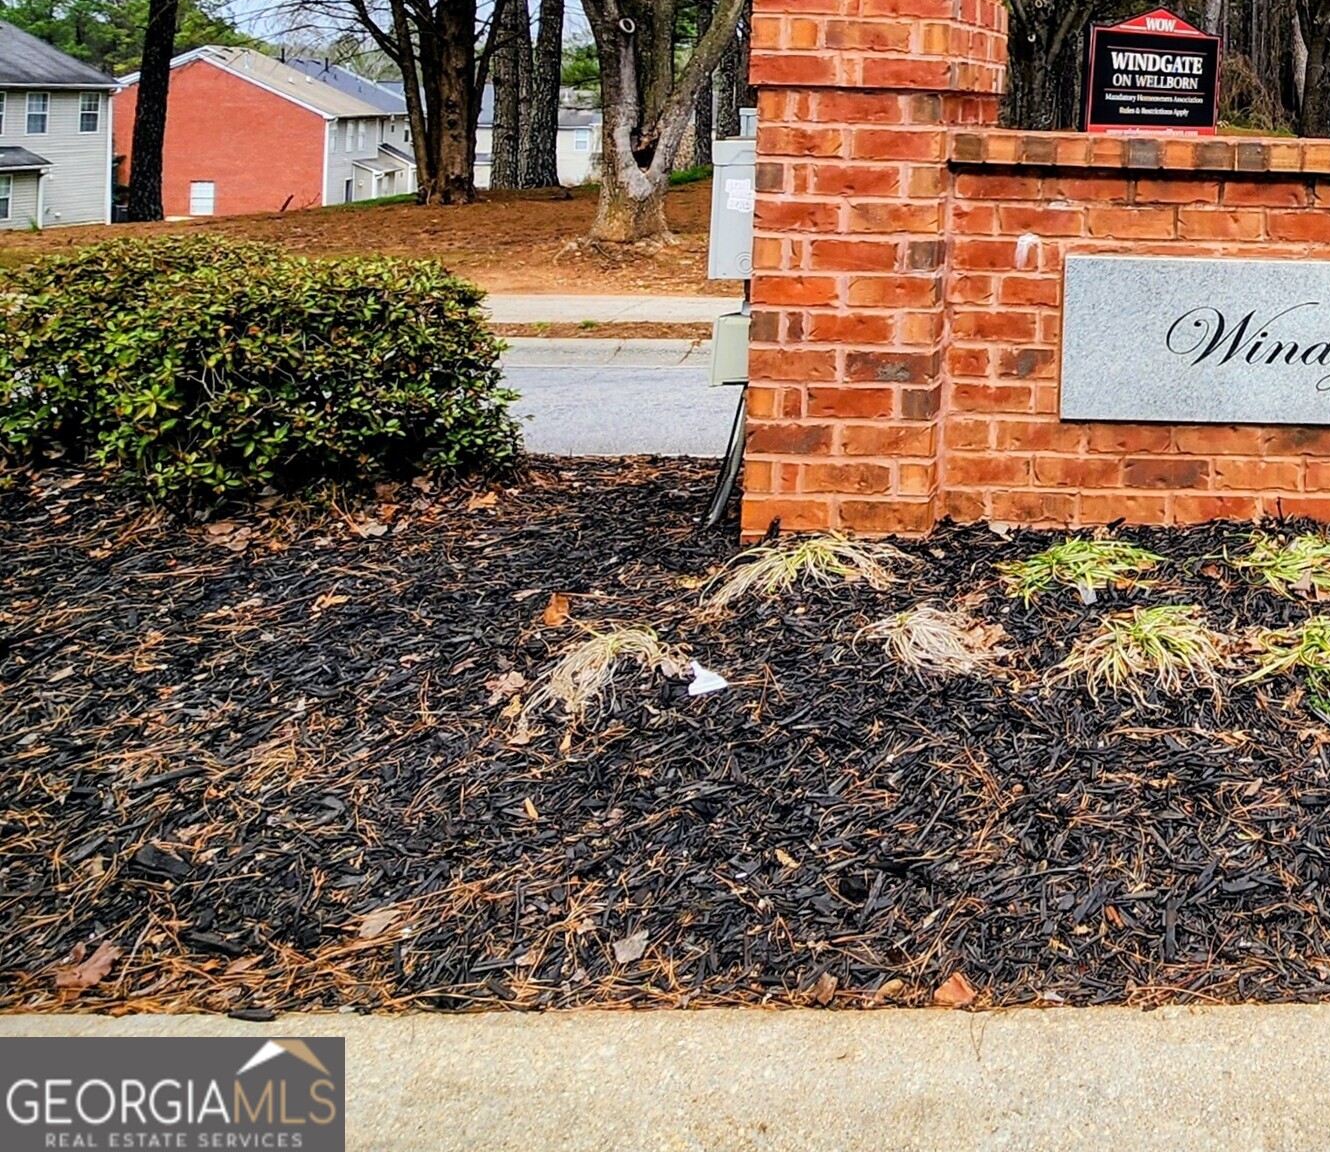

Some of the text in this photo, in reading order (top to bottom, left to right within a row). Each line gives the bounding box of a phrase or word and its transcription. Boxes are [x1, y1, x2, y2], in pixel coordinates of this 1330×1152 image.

[1145, 17, 1177, 32] WOW
[1111, 51, 1203, 75] WINDGATE
[1112, 73, 1199, 89] ON WELLBORN
[1105, 93, 1136, 103] Mandatory
[1173, 108, 1189, 117] Apply
